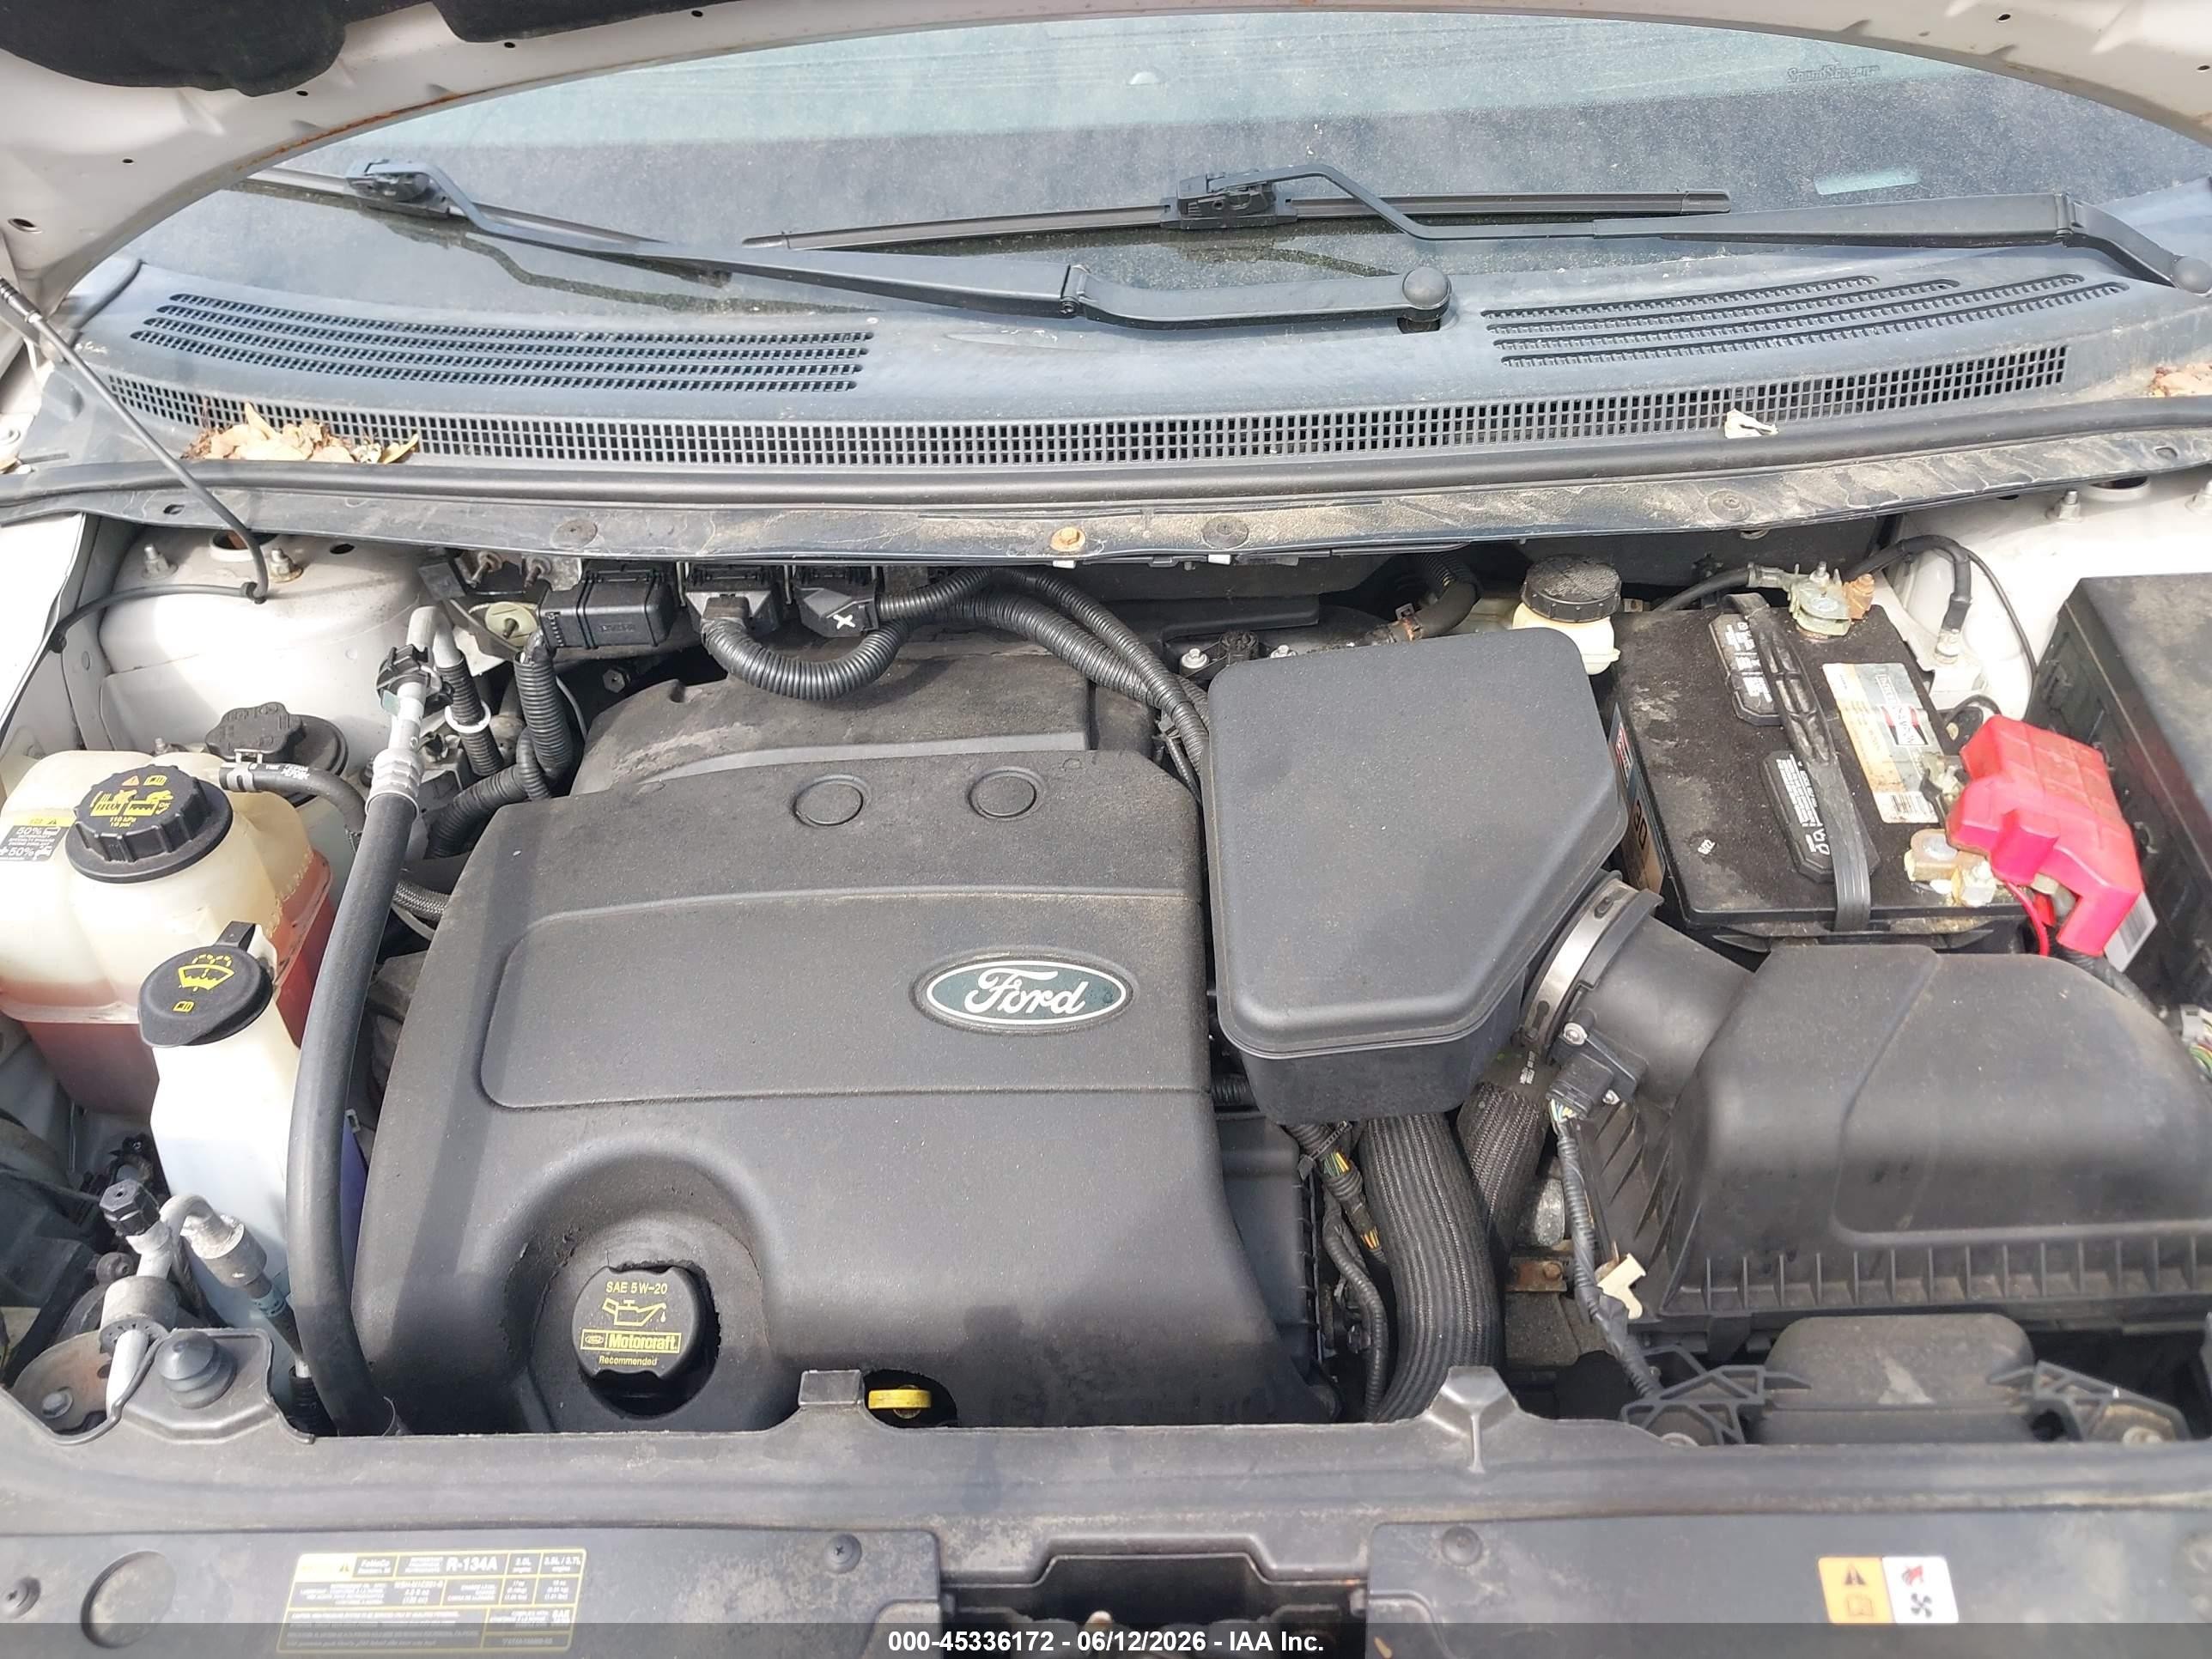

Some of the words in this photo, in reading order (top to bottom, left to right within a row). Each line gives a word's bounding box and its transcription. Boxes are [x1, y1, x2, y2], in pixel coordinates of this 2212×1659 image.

[16, 826, 42, 835] 50%
[963, 967, 1089, 1014] Ford
[605, 1281, 628, 1293] SAE
[599, 1355, 658, 1366] Recommended
[446, 1556, 498, 1572] R-134A
